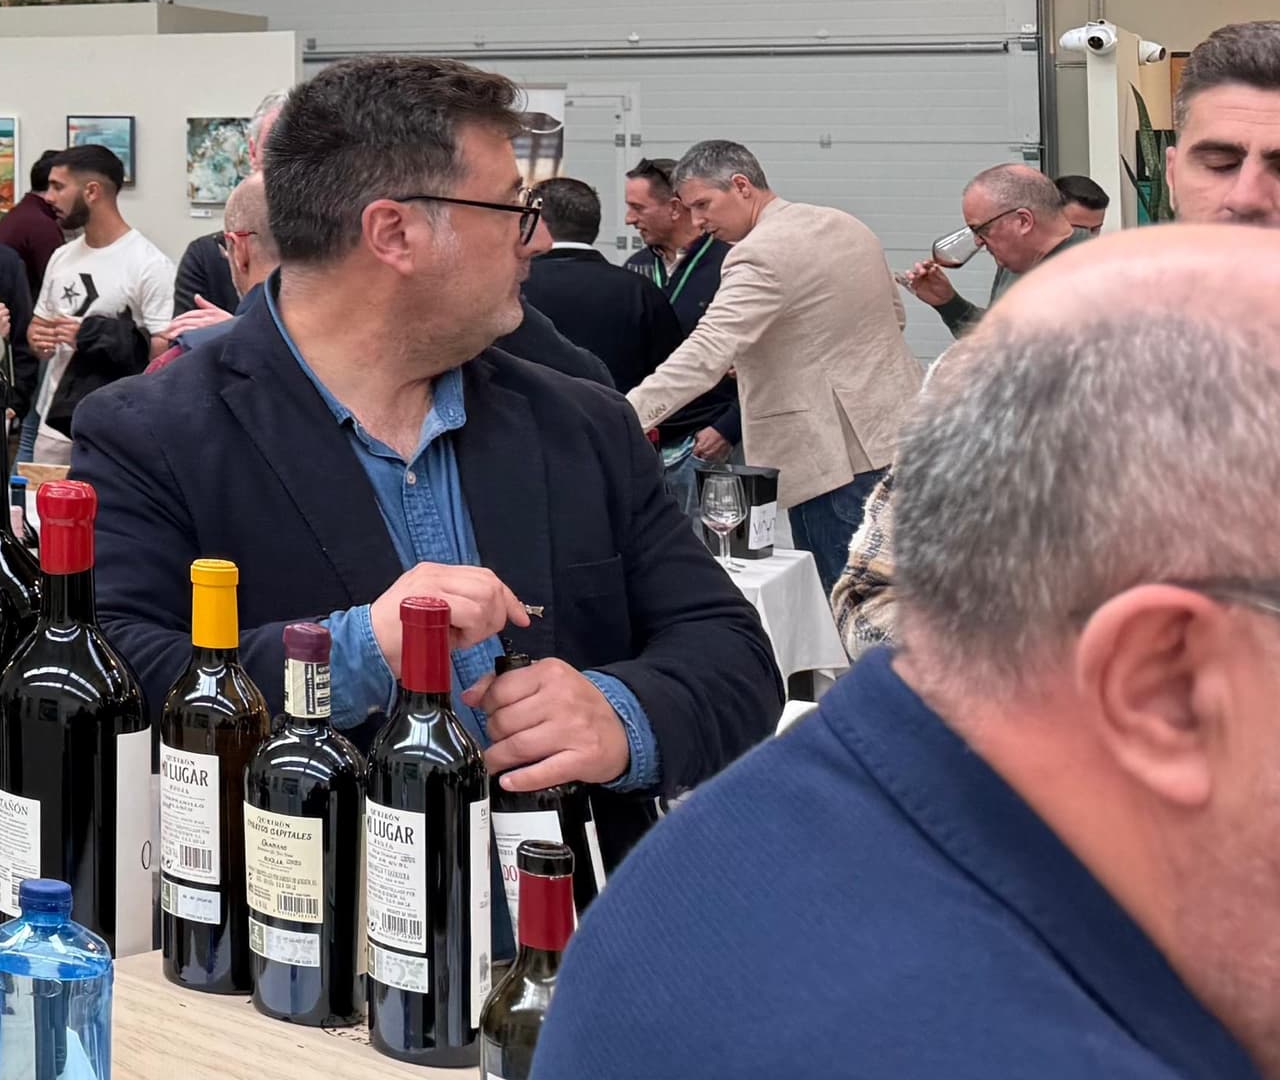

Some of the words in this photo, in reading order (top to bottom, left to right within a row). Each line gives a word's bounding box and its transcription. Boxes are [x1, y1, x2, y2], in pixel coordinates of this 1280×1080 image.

[169, 762, 209, 788] LUGAR
[269, 828, 313, 842] CAPITALES
[374, 818, 415, 846] LUGAR
